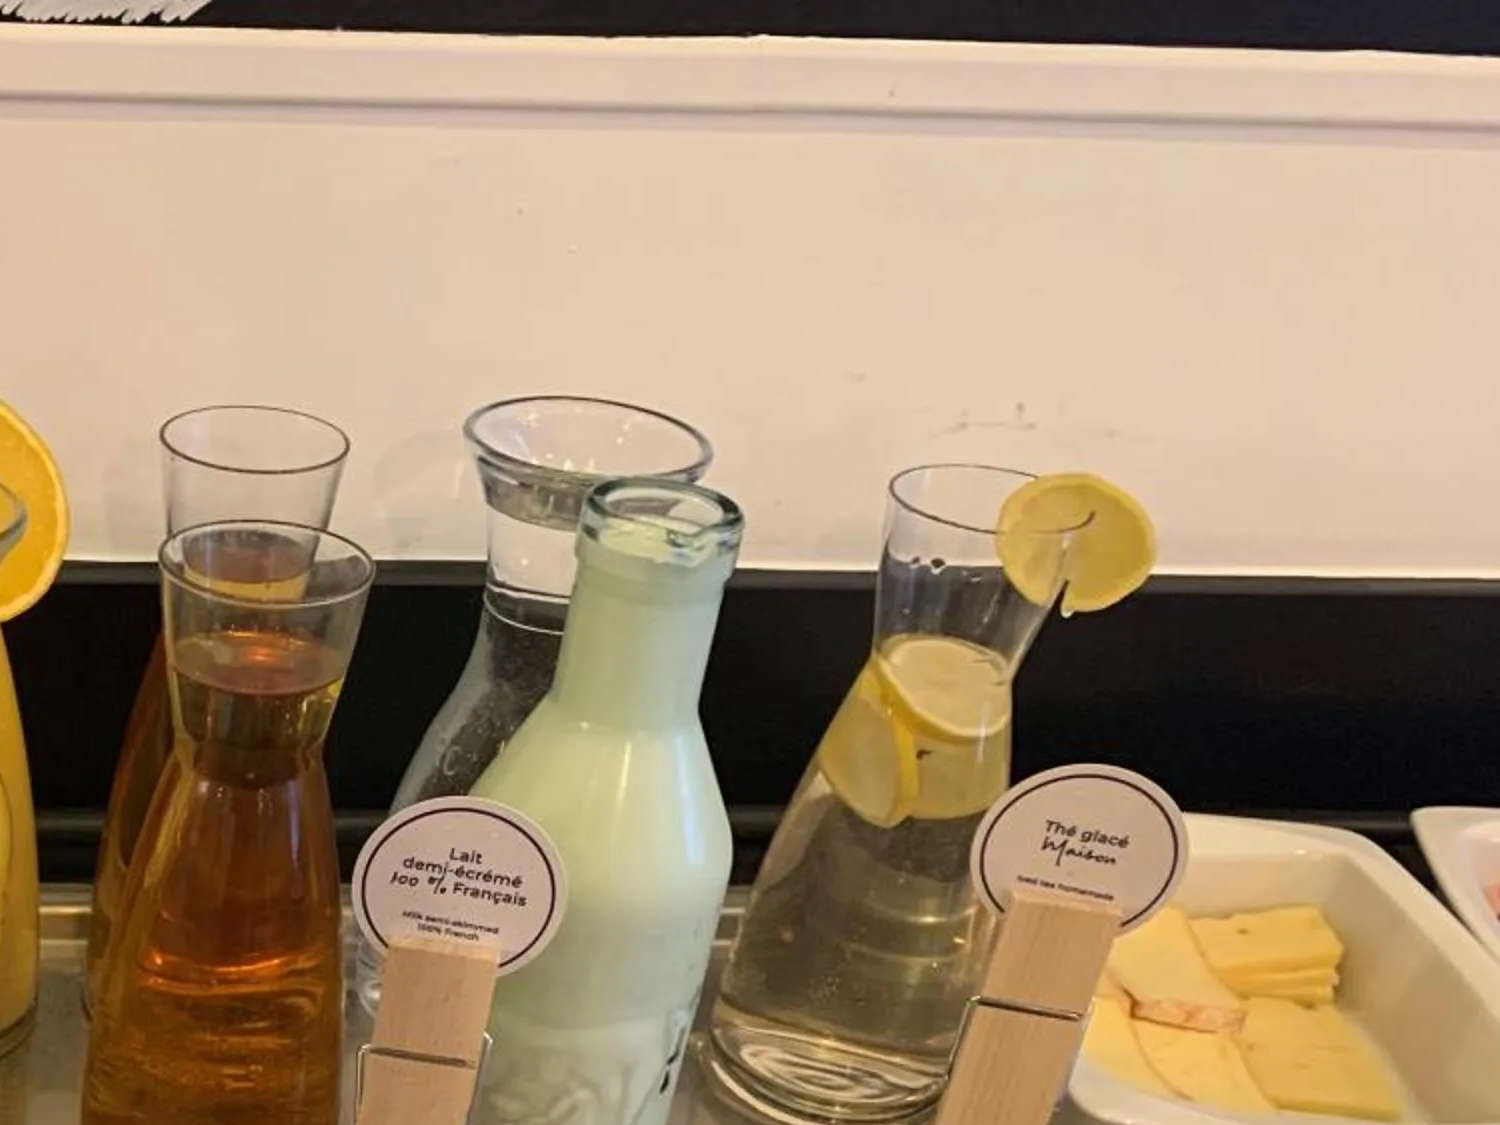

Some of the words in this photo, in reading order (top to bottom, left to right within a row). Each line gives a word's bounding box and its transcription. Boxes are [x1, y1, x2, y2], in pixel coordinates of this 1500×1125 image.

[1045, 819, 1076, 838] Thé
[1080, 827, 1130, 850] glacé
[449, 847, 483, 866] Lait
[402, 855, 523, 889] demi-écrémé
[452, 882, 529, 908] Français
